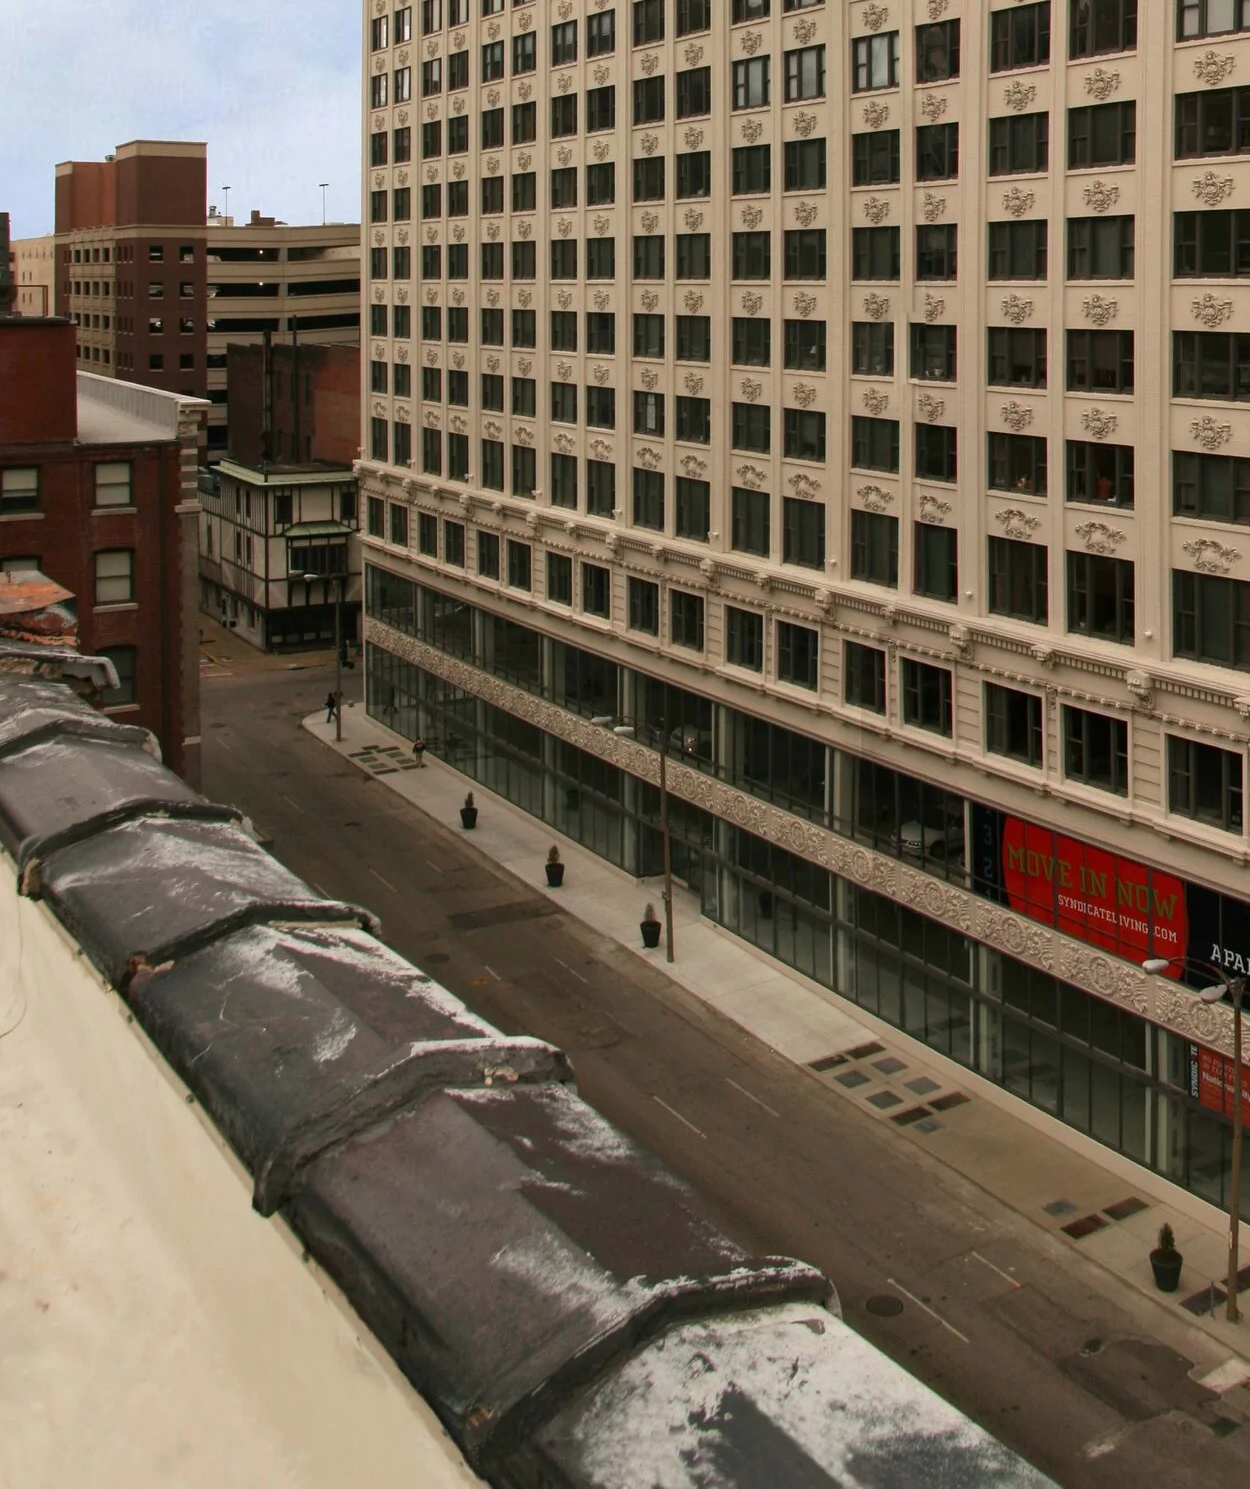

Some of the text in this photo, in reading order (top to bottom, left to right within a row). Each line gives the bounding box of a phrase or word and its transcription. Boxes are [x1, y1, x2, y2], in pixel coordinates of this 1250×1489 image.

[1007, 843, 1178, 921] MOVE IN NOW
[1203, 1071, 1235, 1093] Nationa
